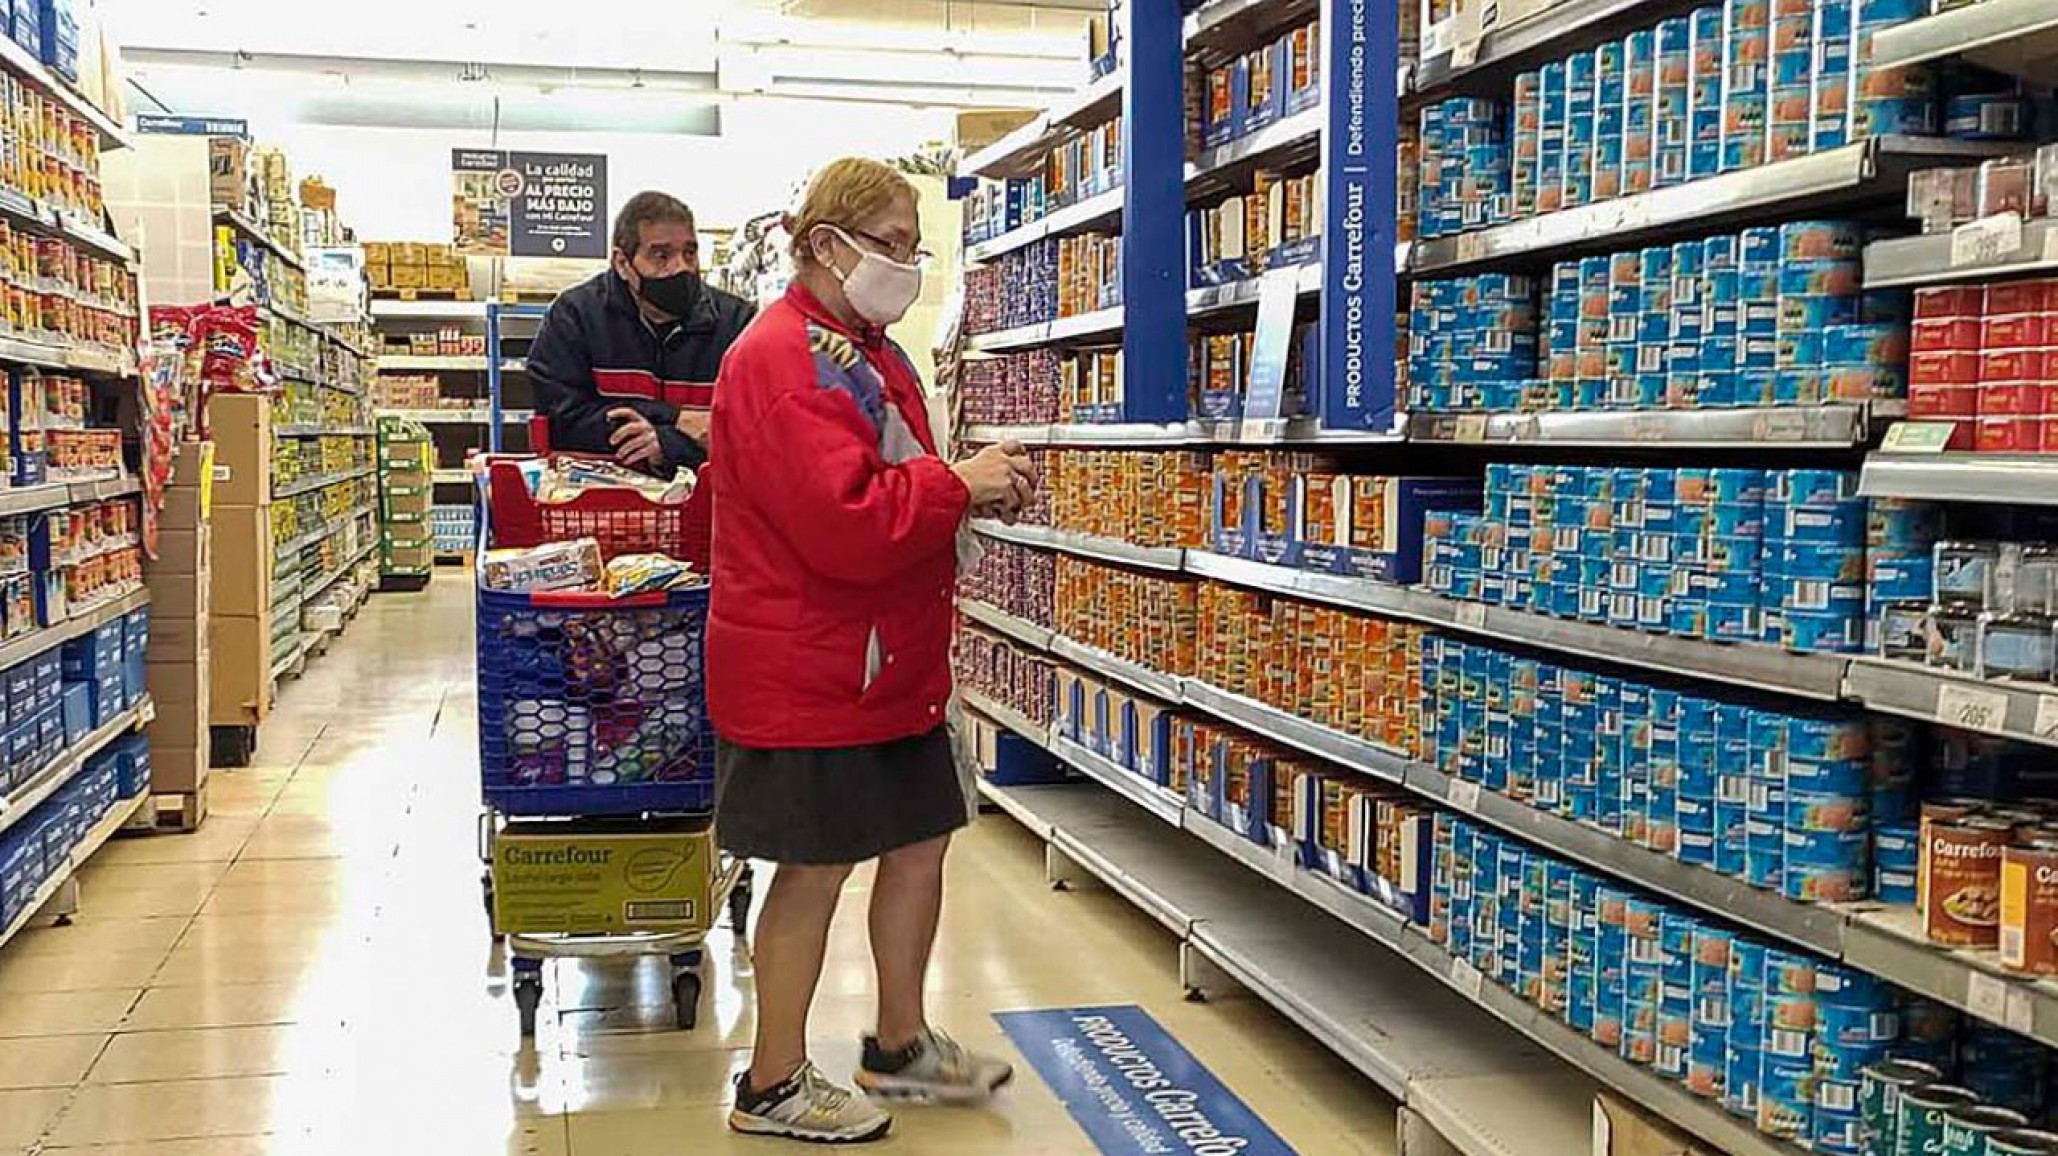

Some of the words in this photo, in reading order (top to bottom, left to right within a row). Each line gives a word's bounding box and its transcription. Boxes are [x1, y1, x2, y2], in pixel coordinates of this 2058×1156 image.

[1348, 47, 1365, 156] Defendiendo
[526, 163, 542, 175] La
[545, 163, 593, 177] calidad
[525, 185, 542, 196] AL
[545, 185, 594, 197] PRECIO
[526, 197, 556, 211] MÁS
[558, 200, 593, 212] BAJO
[555, 212, 594, 222] Carrefour
[1343, 182, 1364, 291] Carrefour
[1345, 297, 1362, 408] PRODUCTOS
[505, 845, 613, 865] Carrefour
[1071, 1014, 1172, 1089] PRODUCTOS
[1144, 1089, 1249, 1156] Carrefo
